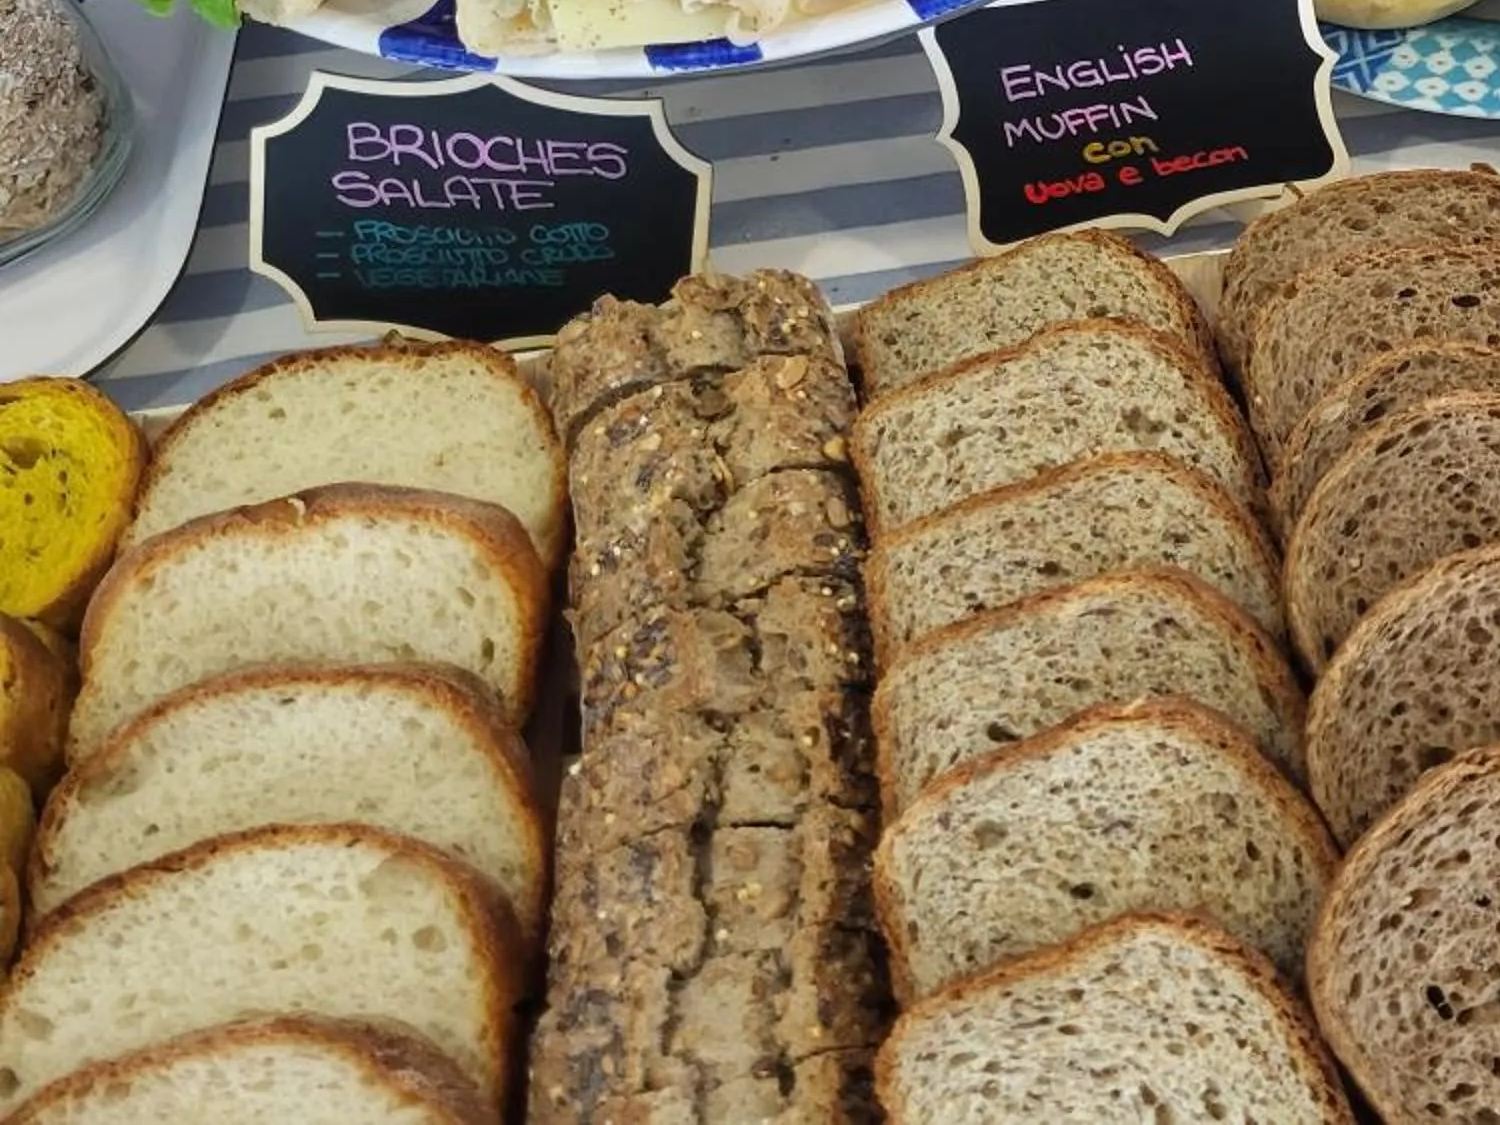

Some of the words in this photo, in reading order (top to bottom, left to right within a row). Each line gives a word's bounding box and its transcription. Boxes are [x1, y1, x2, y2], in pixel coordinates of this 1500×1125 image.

[1003, 94, 1160, 150] MUFFIN
[345, 121, 630, 180] BRIOCHES
[1084, 136, 1158, 163] con
[1119, 166, 1142, 184] e
[1153, 146, 1248, 176] becon
[331, 170, 556, 212] SALATE
[529, 221, 611, 243] COTTO
